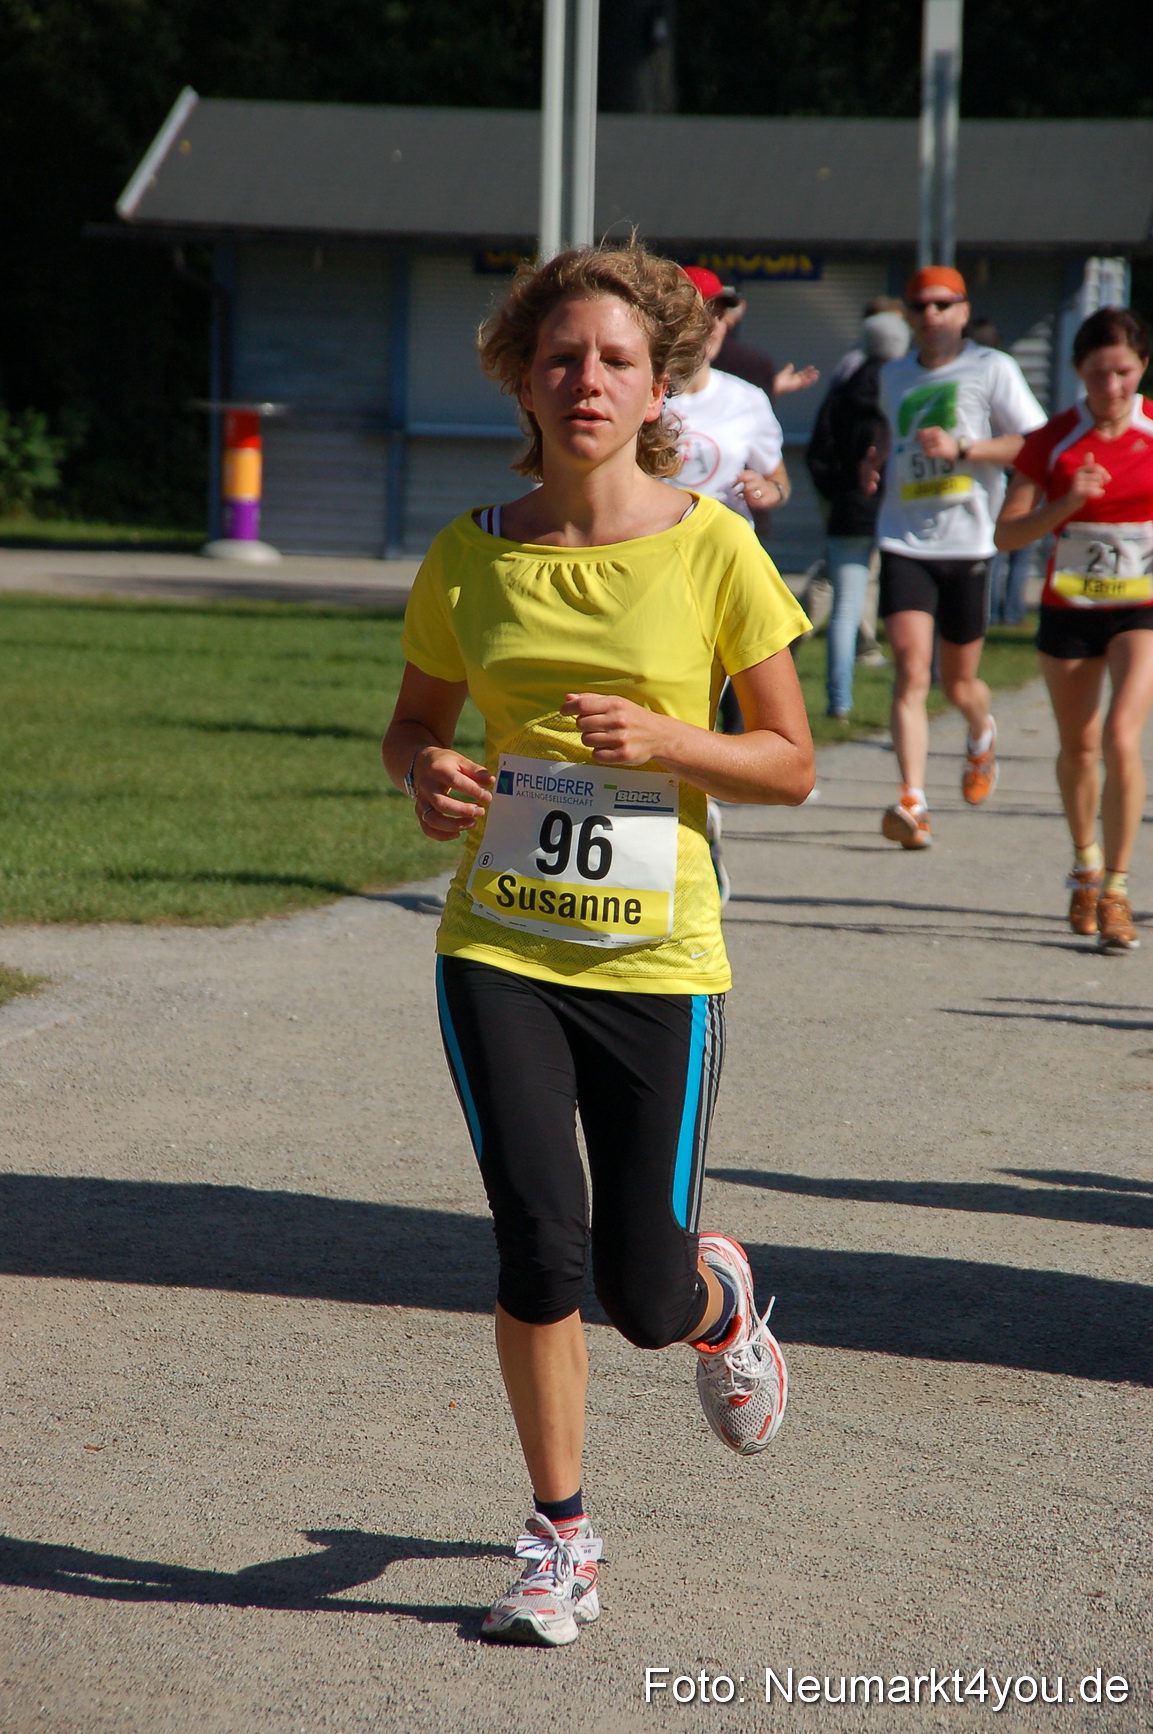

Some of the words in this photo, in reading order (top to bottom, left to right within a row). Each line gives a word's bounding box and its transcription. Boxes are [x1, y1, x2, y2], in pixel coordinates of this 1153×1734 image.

[1087, 543, 1120, 575] 21
[515, 772, 594, 797] PFLEIDERER
[515, 790, 594, 807] AKTIENGESELLSCHAFT
[615, 790, 661, 803] BOCK
[535, 809, 614, 880] 96
[496, 875, 642, 925] Susanne
